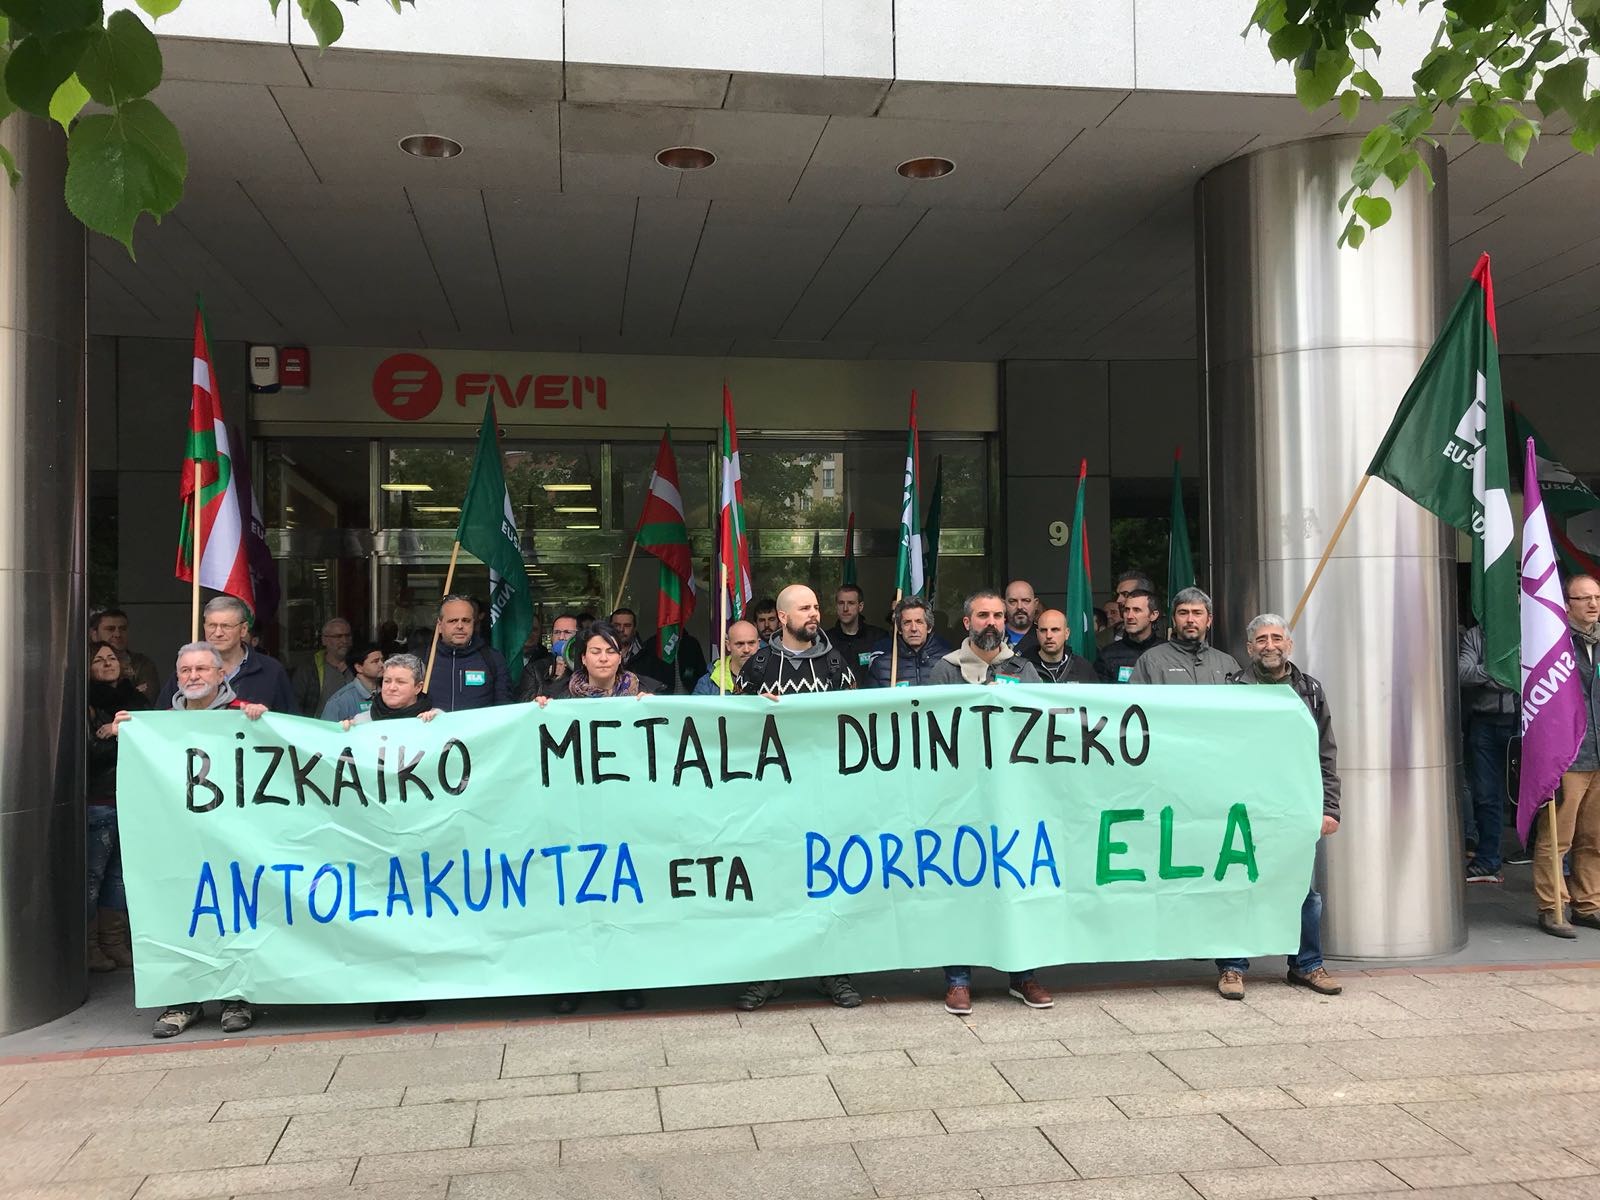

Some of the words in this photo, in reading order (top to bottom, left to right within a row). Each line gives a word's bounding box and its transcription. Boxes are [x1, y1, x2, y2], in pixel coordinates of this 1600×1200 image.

[455, 373, 608, 410] FVEM
[1049, 520, 1069, 547] 9
[538, 715, 792, 789] METALA
[188, 842, 644, 938] ANTOLAKUNTZA
[669, 855, 754, 902] ETA
[806, 820, 1061, 899] BORROKA
[1095, 803, 1260, 885] ELA
